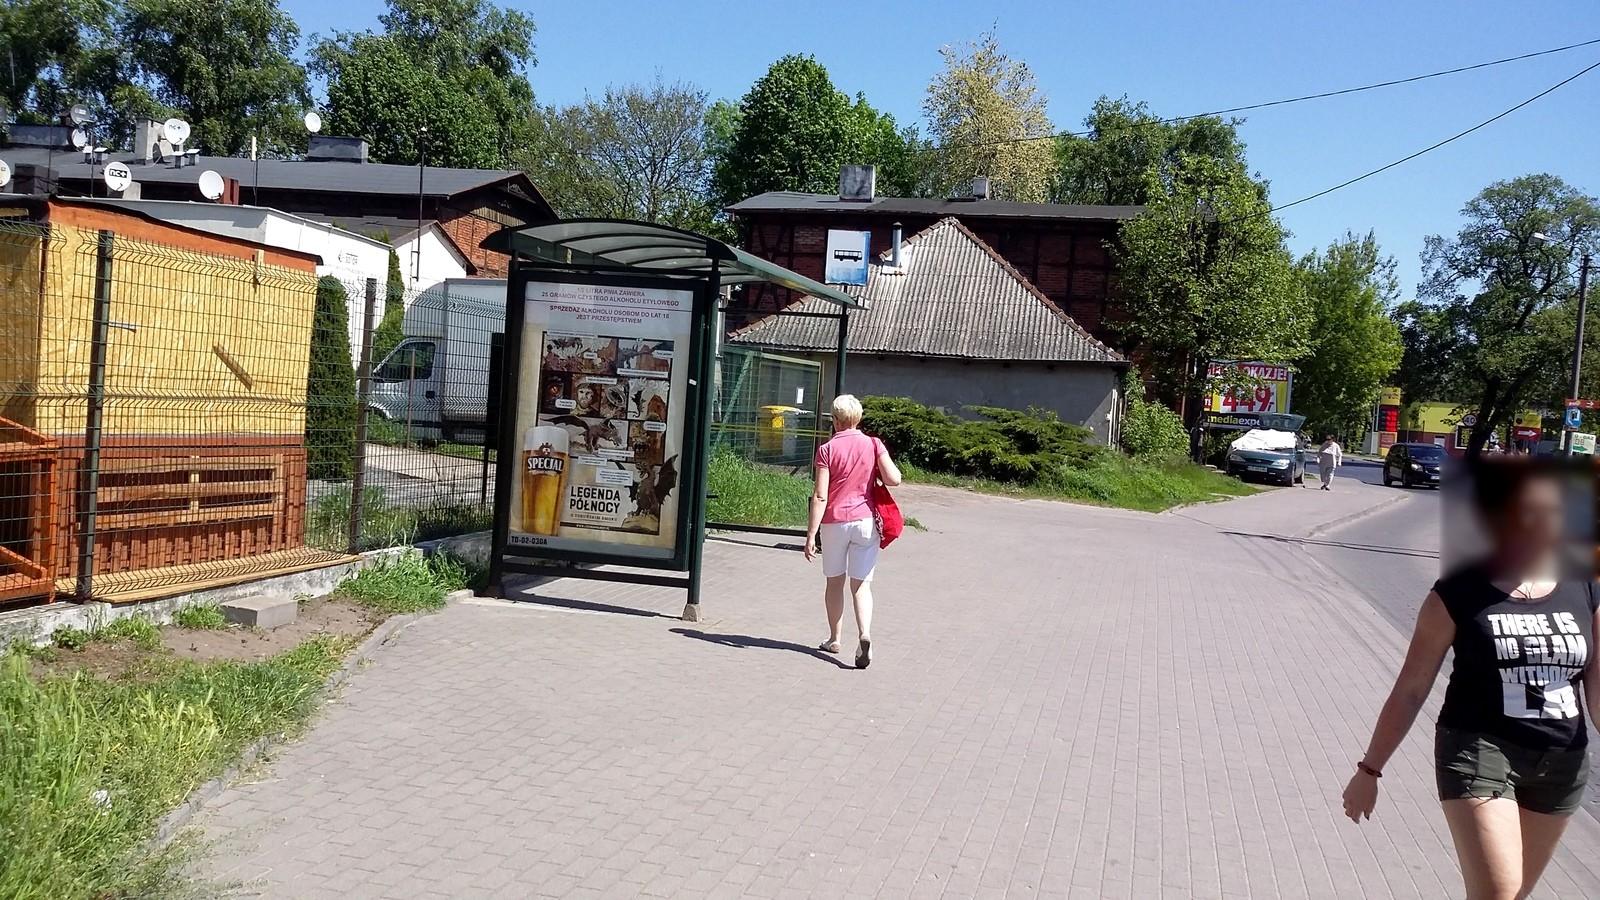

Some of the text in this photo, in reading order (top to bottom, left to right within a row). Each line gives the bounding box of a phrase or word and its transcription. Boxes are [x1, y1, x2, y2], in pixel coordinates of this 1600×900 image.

[109, 169, 127, 178] nc+
[609, 296, 643, 304] ALKOHOLU
[581, 307, 613, 315] ALKOHOLU
[570, 486, 621, 501] LEGENDA
[569, 498, 620, 514] PÓŁNOCY
[1487, 612, 1581, 636] THERE IS
[1494, 634, 1588, 666] NO SLAM
[1498, 665, 1584, 687] WITHOUT
